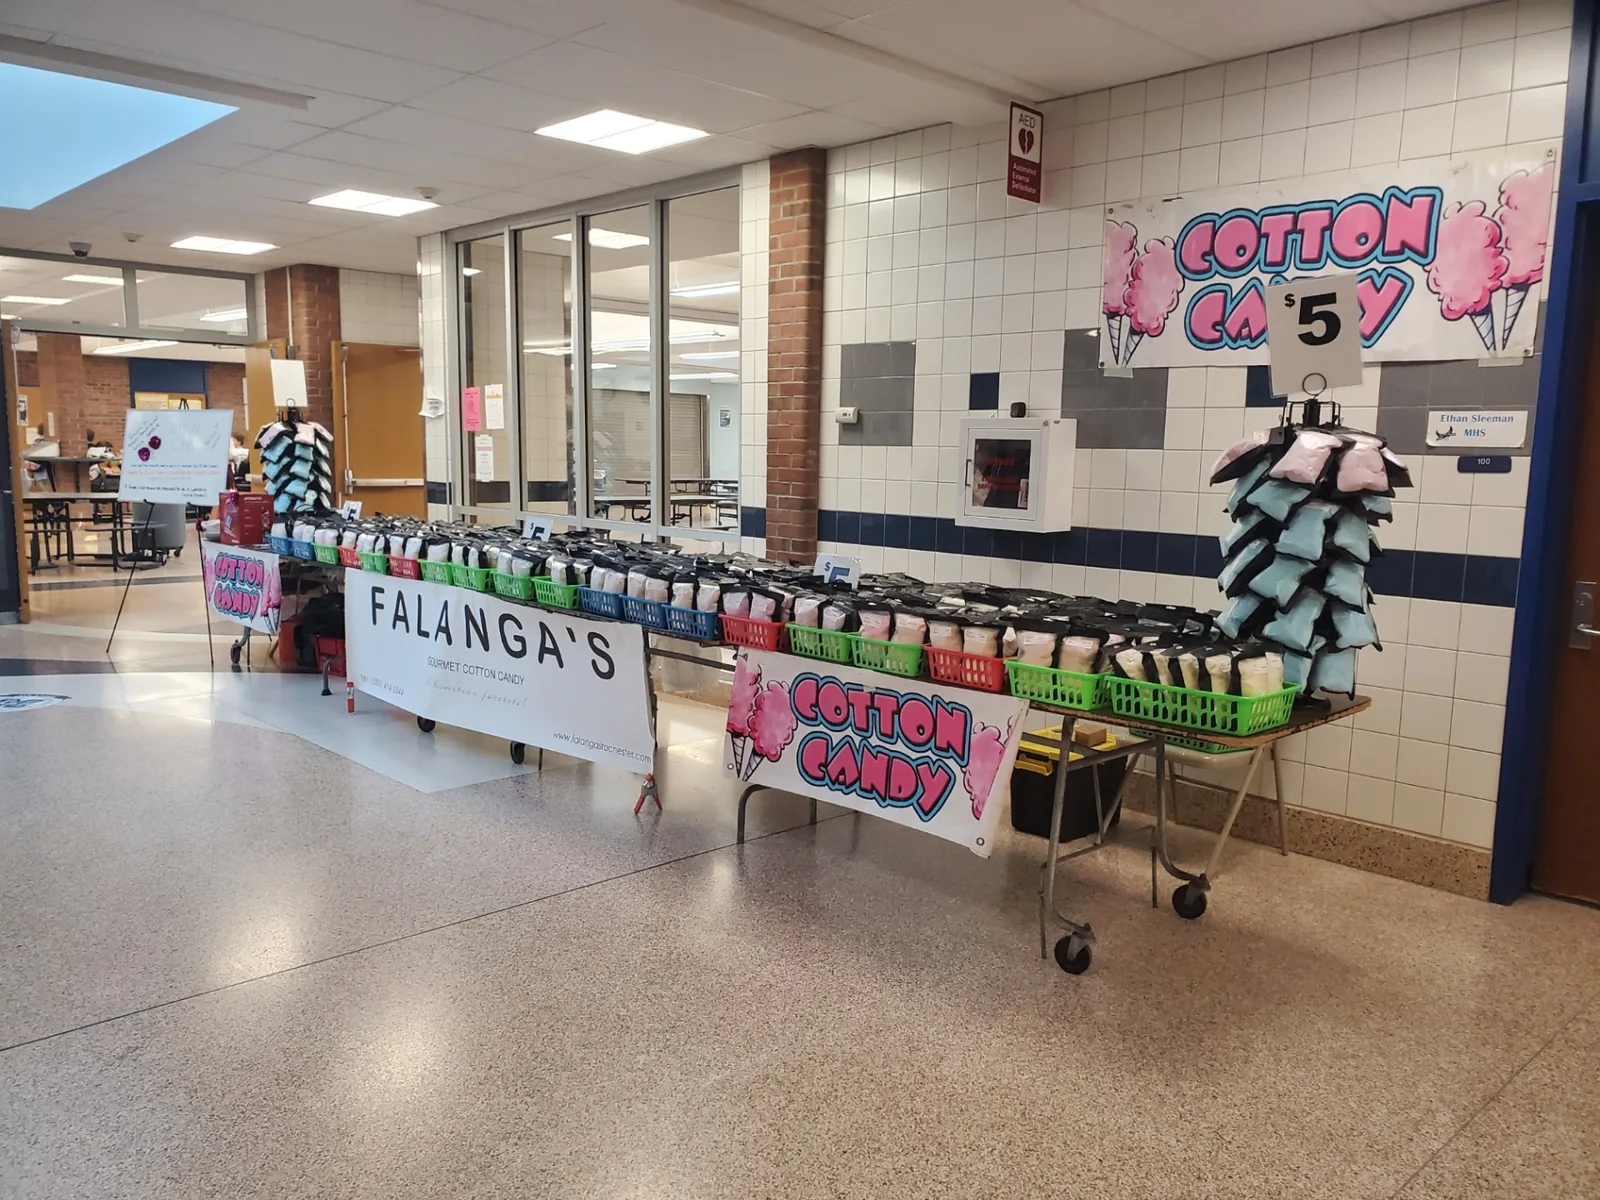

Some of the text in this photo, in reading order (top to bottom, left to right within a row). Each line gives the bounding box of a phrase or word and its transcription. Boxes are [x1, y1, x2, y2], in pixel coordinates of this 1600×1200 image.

[1018, 113, 1036, 129] AED
[1176, 186, 1442, 280] COTTON
[1185, 266, 1413, 350] CAY
[1284, 291, 1342, 346] $5
[1440, 414, 1514, 423] Ethan Sleeman
[1464, 428, 1486, 437] MHS
[1477, 457, 1491, 465] 100
[214, 552, 265, 588] COTTON
[213, 583, 261, 622] CANDY
[371, 585, 616, 681] FALANGA'S
[427, 655, 525, 687] GOURMET COTTON CANDY
[791, 673, 972, 767] COTTON
[552, 731, 653, 764] www.falangasrochester.com
[797, 732, 956, 822] CANDY
